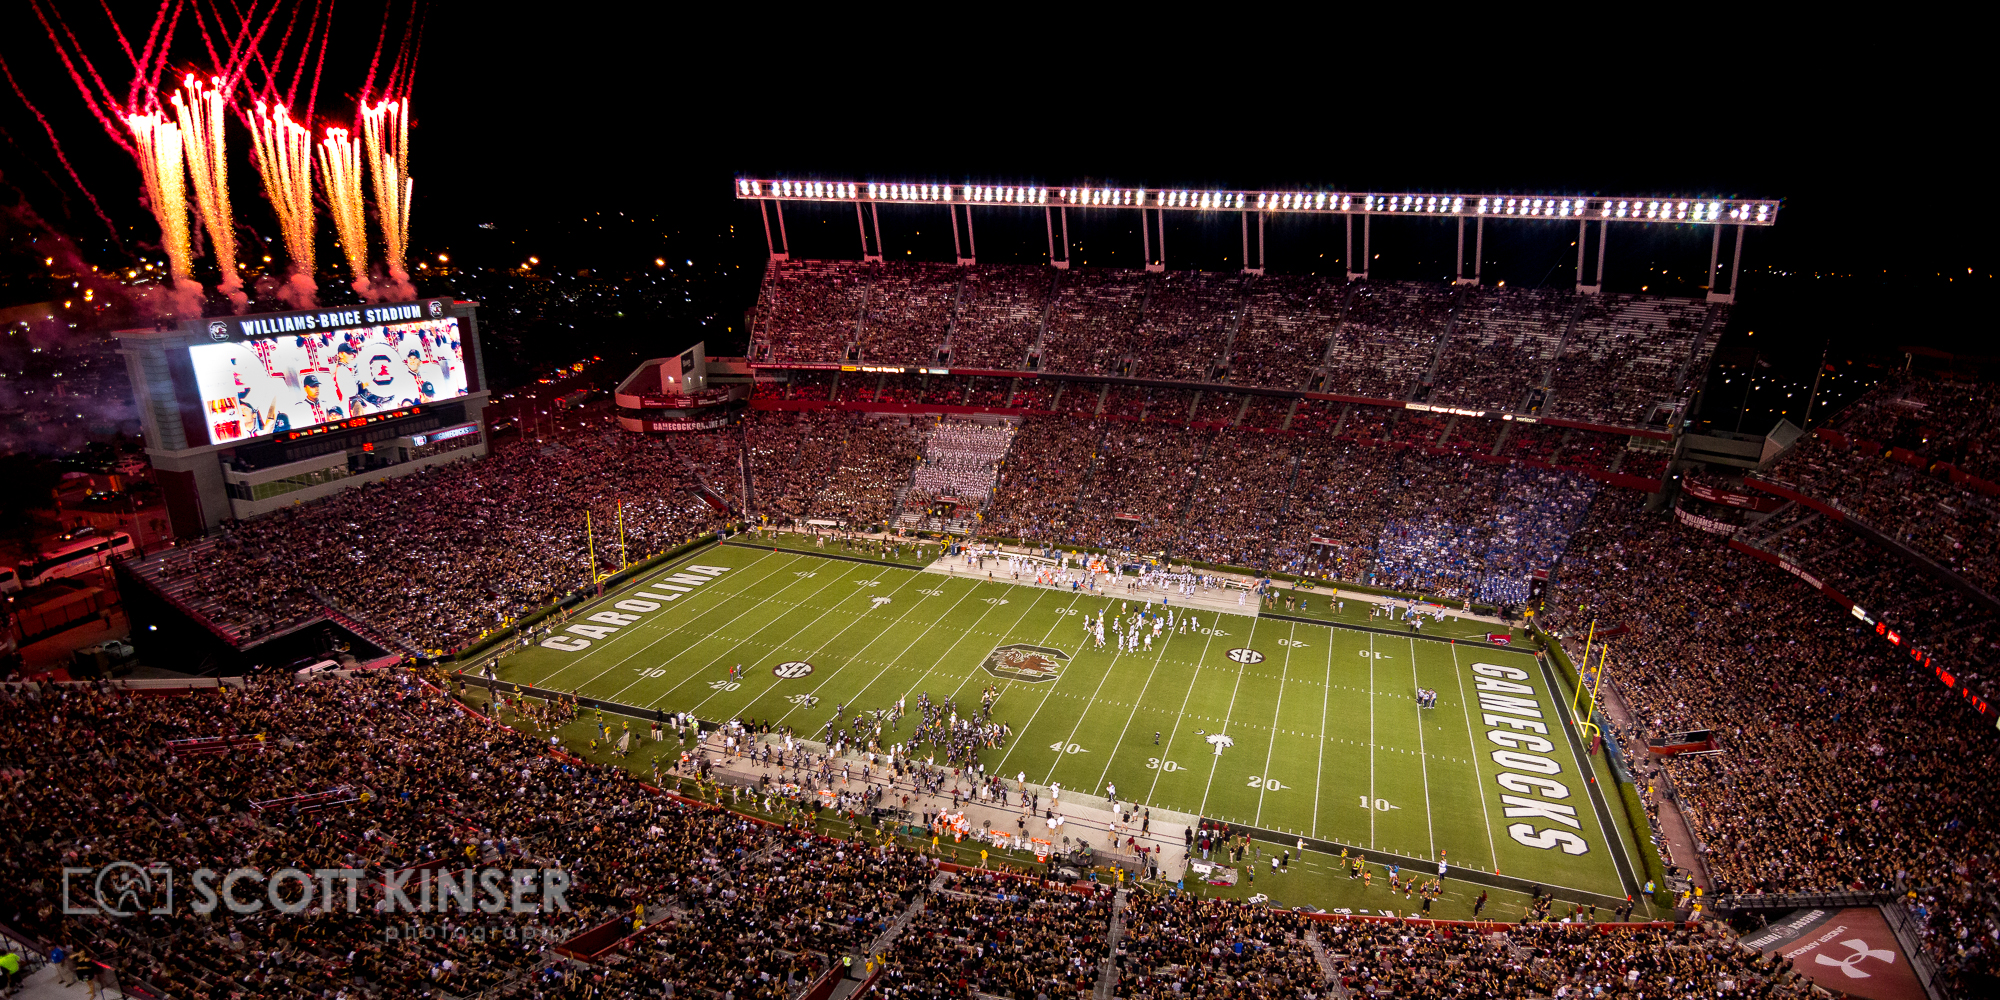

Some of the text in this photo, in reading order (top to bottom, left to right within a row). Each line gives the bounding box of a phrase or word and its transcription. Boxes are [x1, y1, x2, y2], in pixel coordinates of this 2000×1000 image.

[240, 305, 422, 336] WILLIAMS-BRICE STADIUM
[539, 564, 733, 652] CAROLINA
[1228, 648, 1263, 664] SEC
[638, 667, 667, 678] 10
[774, 661, 813, 679] SEC
[709, 680, 741, 692] 20
[1049, 741, 1081, 755] 40
[1145, 757, 1178, 773] 30
[1470, 662, 1590, 857] GAMECOCKS
[1246, 775, 1281, 792] 20
[1359, 795, 1390, 812] 10
[1783, 925, 1848, 959] UNDER ARMOUR
